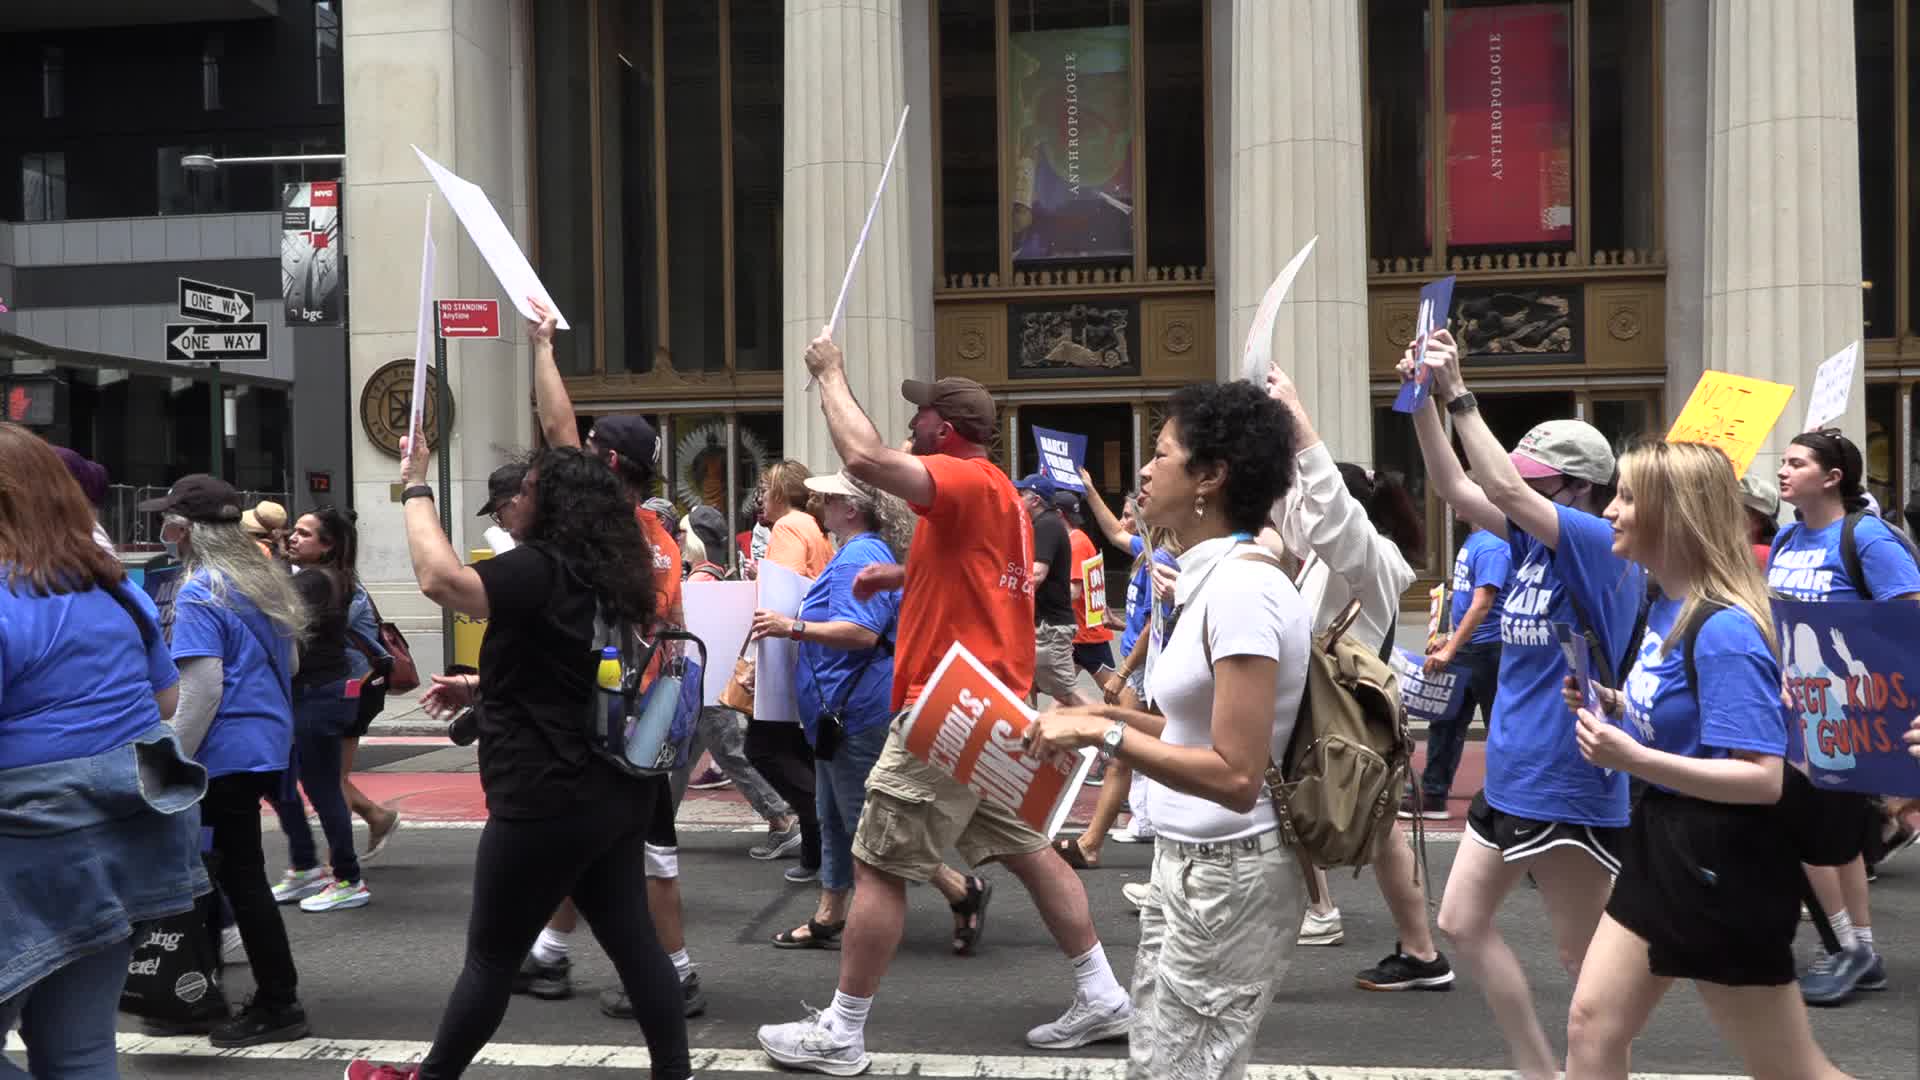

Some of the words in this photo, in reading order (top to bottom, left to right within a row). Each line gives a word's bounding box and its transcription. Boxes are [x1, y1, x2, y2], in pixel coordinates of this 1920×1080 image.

[1489, 33, 1503, 180] ANTHROPOLOGIE
[1065, 53, 1080, 196] ANTHROPOLOGIE
[191, 293, 213, 310] ONE
[222, 299, 244, 316] WAY
[442, 303, 452, 311] NO
[453, 303, 488, 311] STANDING
[302, 308, 323, 322] bgc
[442, 312, 470, 320] Anytime
[181, 335, 210, 350] ONE
[223, 335, 255, 349] WAY
[1695, 381, 1753, 414] NOT
[1040, 436, 1069, 456] MARCH
